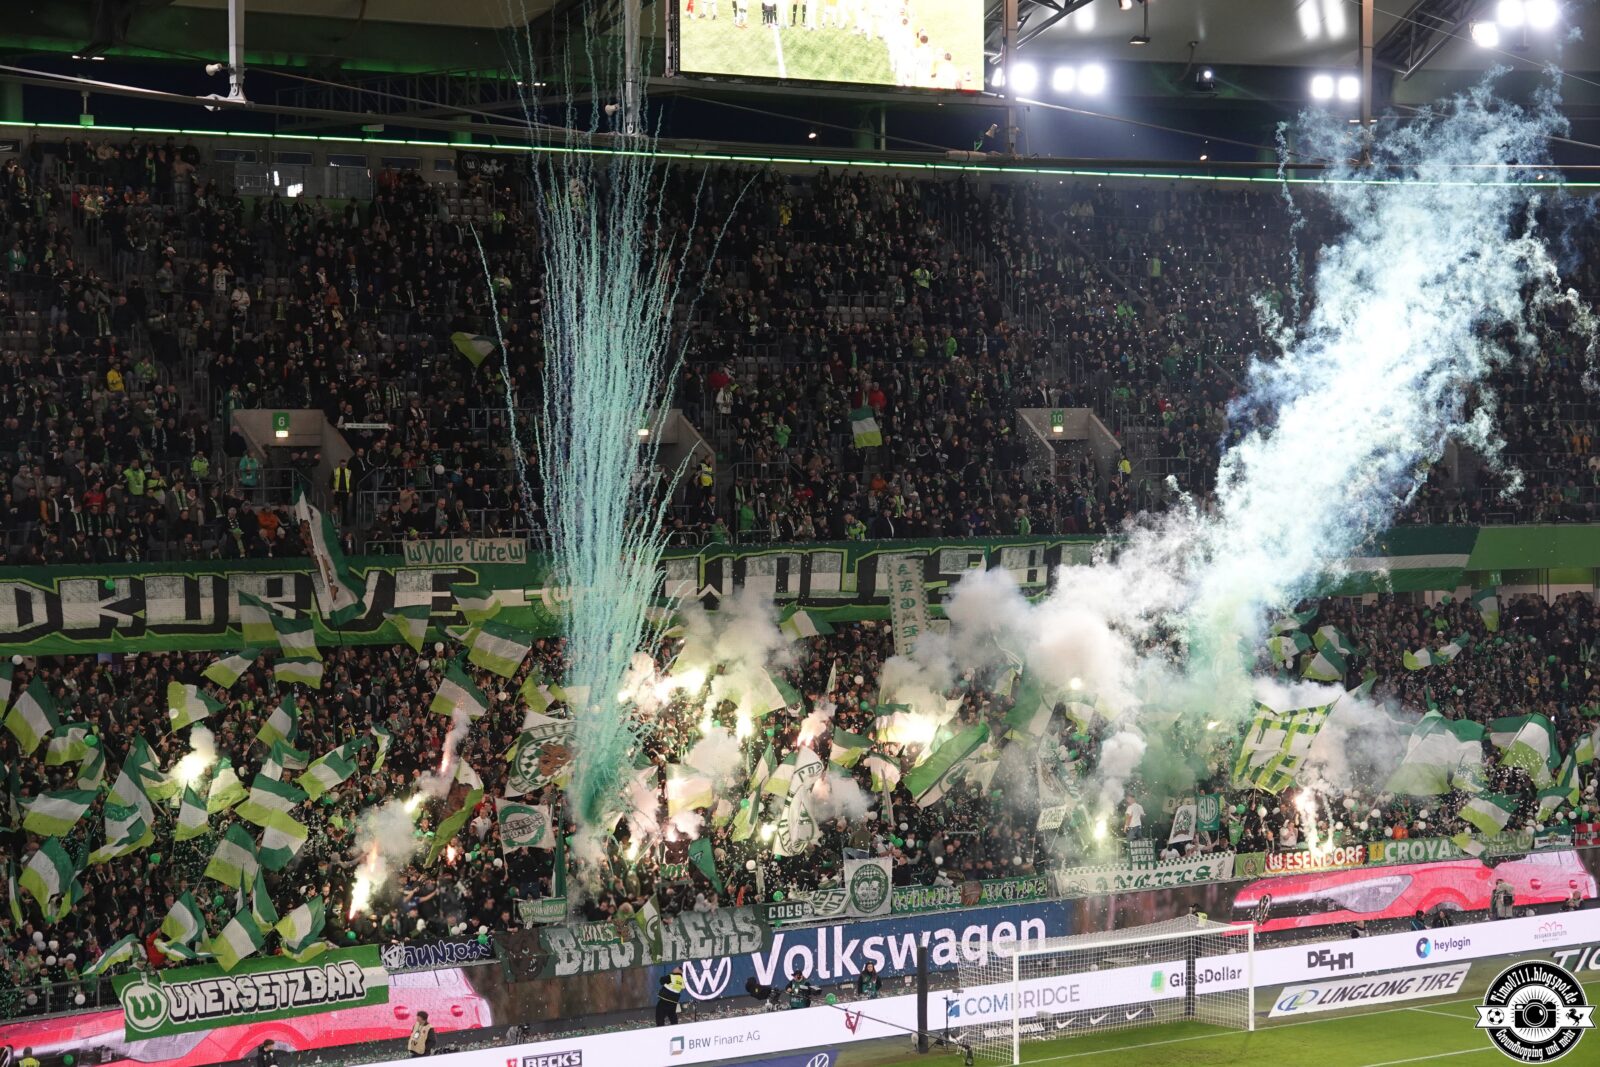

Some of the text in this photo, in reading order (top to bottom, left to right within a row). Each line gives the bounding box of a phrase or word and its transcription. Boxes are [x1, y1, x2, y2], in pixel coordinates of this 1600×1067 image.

[1384, 836, 1450, 863] CROYA
[751, 917, 1047, 985] Volkswagen
[1434, 936, 1471, 953] heylogin
[165, 961, 367, 1022] UNERSETZBAR
[1317, 970, 1465, 1005] LINGLONG TIRE
[689, 1031, 761, 1049] BRW Finanz AG
[525, 1051, 580, 1067] BECK'S
